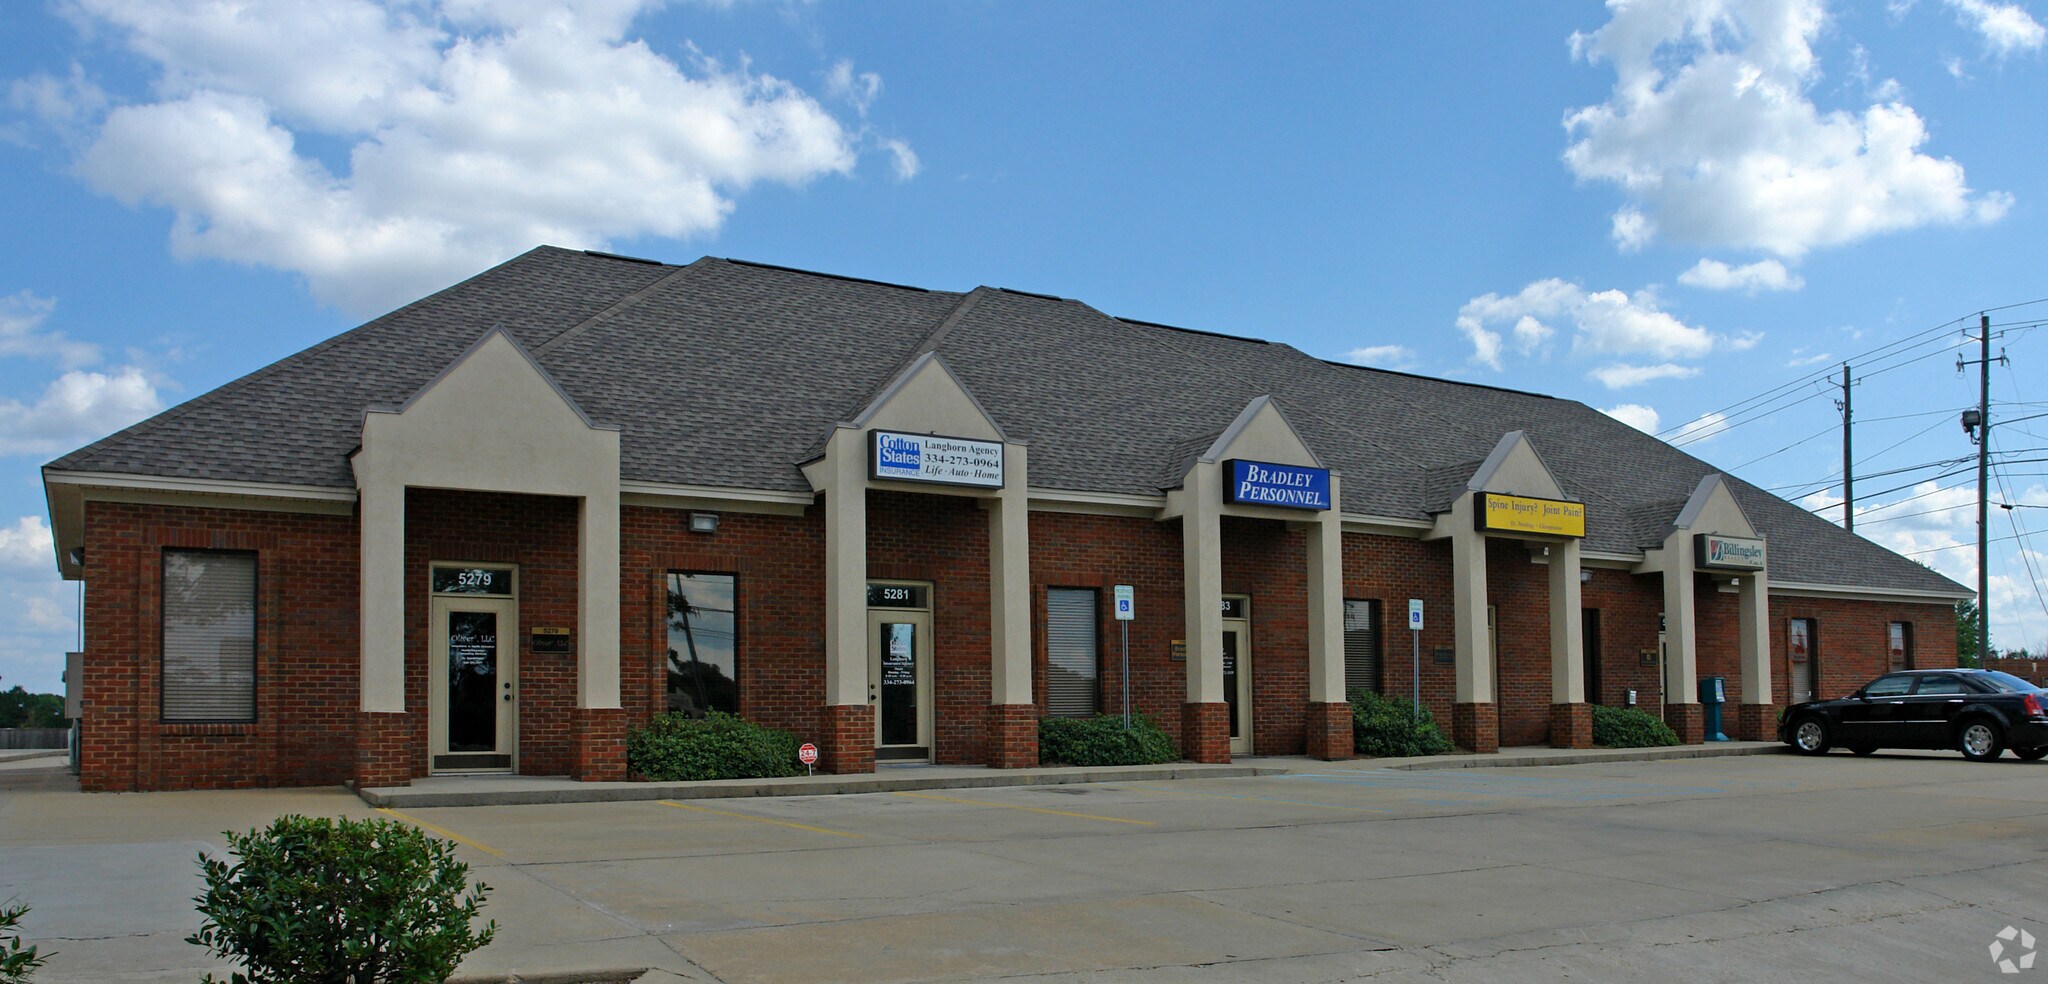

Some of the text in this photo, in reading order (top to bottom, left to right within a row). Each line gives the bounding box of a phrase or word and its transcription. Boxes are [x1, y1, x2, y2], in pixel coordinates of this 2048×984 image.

[880, 434, 920, 452] Cotton
[925, 440, 999, 457] Langhorn Agency
[882, 447, 920, 466] States
[925, 453, 1000, 469] 334-273-0964
[880, 466, 920, 477] INSURANCE
[925, 465, 1000, 480] Life Auto Home
[1246, 464, 1313, 488] BRADLEY
[1239, 481, 1321, 506] PERSONNEL
[1488, 498, 1583, 517] Spine Injury? Joint Pain?
[1724, 542, 1763, 559] Billingsley
[458, 573, 492, 586] 5279
[884, 588, 909, 600] 5281
[481, 634, 496, 643] LLC
